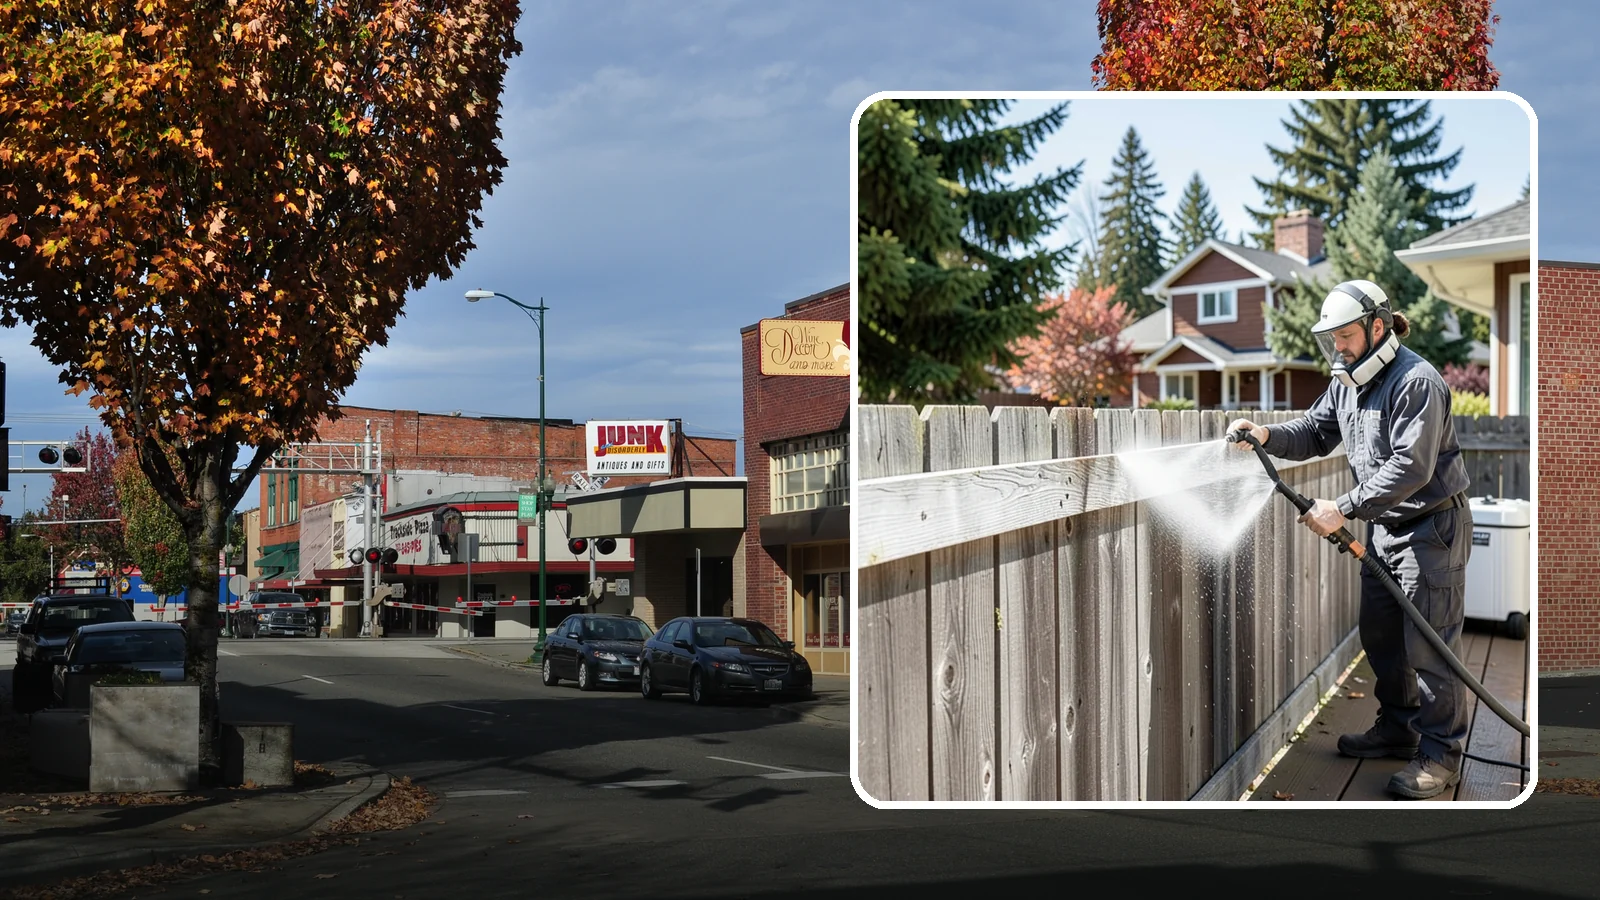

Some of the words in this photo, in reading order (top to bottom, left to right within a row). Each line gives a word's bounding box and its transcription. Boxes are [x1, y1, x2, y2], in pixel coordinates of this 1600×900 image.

[596, 425, 665, 457] JUNK
[607, 446, 646, 454] DISORDERLY
[597, 461, 628, 470] ANTIQUES
[631, 461, 644, 470] AND
[647, 460, 666, 470] GIFTS
[573, 473, 589, 492] RAIL
[590, 475, 608, 491] SING
[414, 519, 429, 535] Pizza
